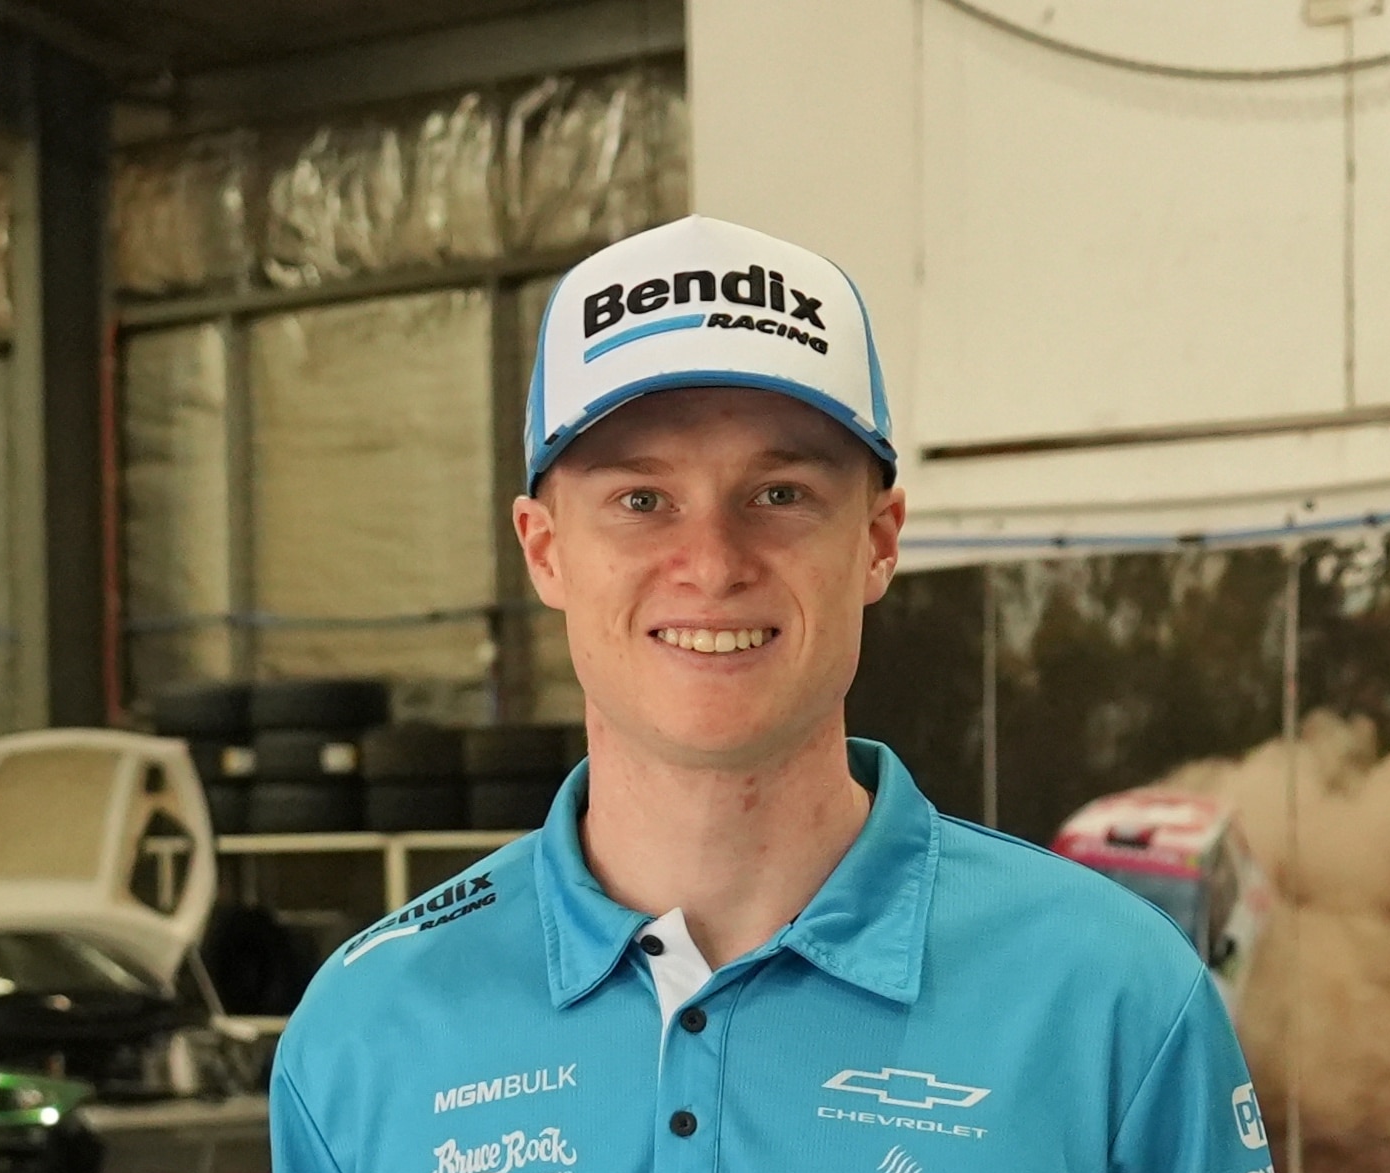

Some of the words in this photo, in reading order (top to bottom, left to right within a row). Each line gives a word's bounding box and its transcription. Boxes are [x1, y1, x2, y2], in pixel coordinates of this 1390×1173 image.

[584, 265, 826, 339] Bendix
[707, 313, 828, 355] RACING
[419, 892, 497, 932] RACING
[433, 1063, 577, 1114] MGMBULK
[817, 1107, 988, 1139] CHEVROLET
